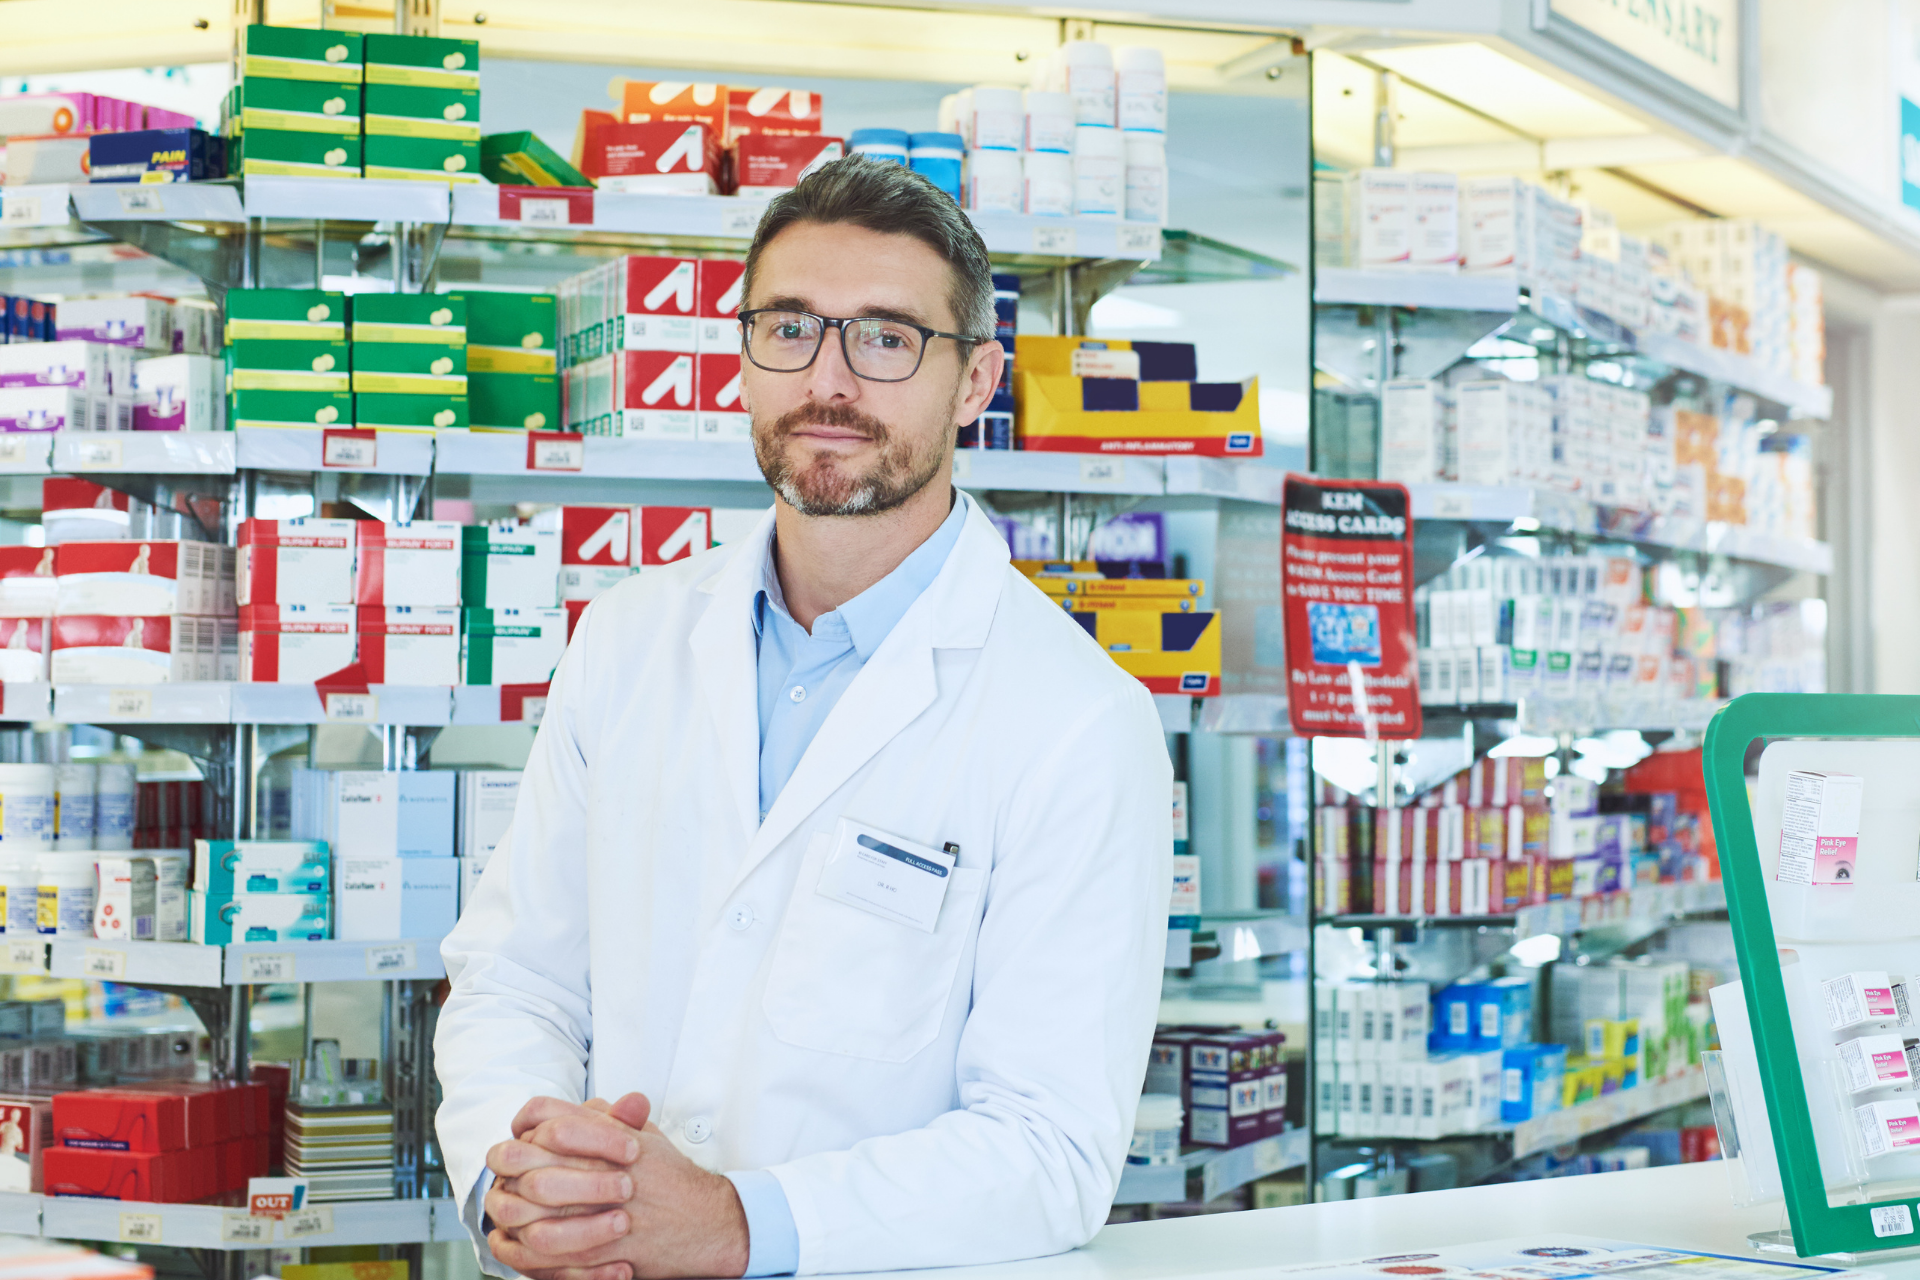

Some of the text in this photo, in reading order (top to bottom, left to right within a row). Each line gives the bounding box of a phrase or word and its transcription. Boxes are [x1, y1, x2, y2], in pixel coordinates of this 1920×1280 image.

[151, 149, 187, 164] PAIN
[1338, 515, 1406, 535] CARDS
[1820, 838, 1847, 848] Pink Eye
[1819, 847, 1838, 856] Relief
[256, 1195, 290, 1208] OUT
